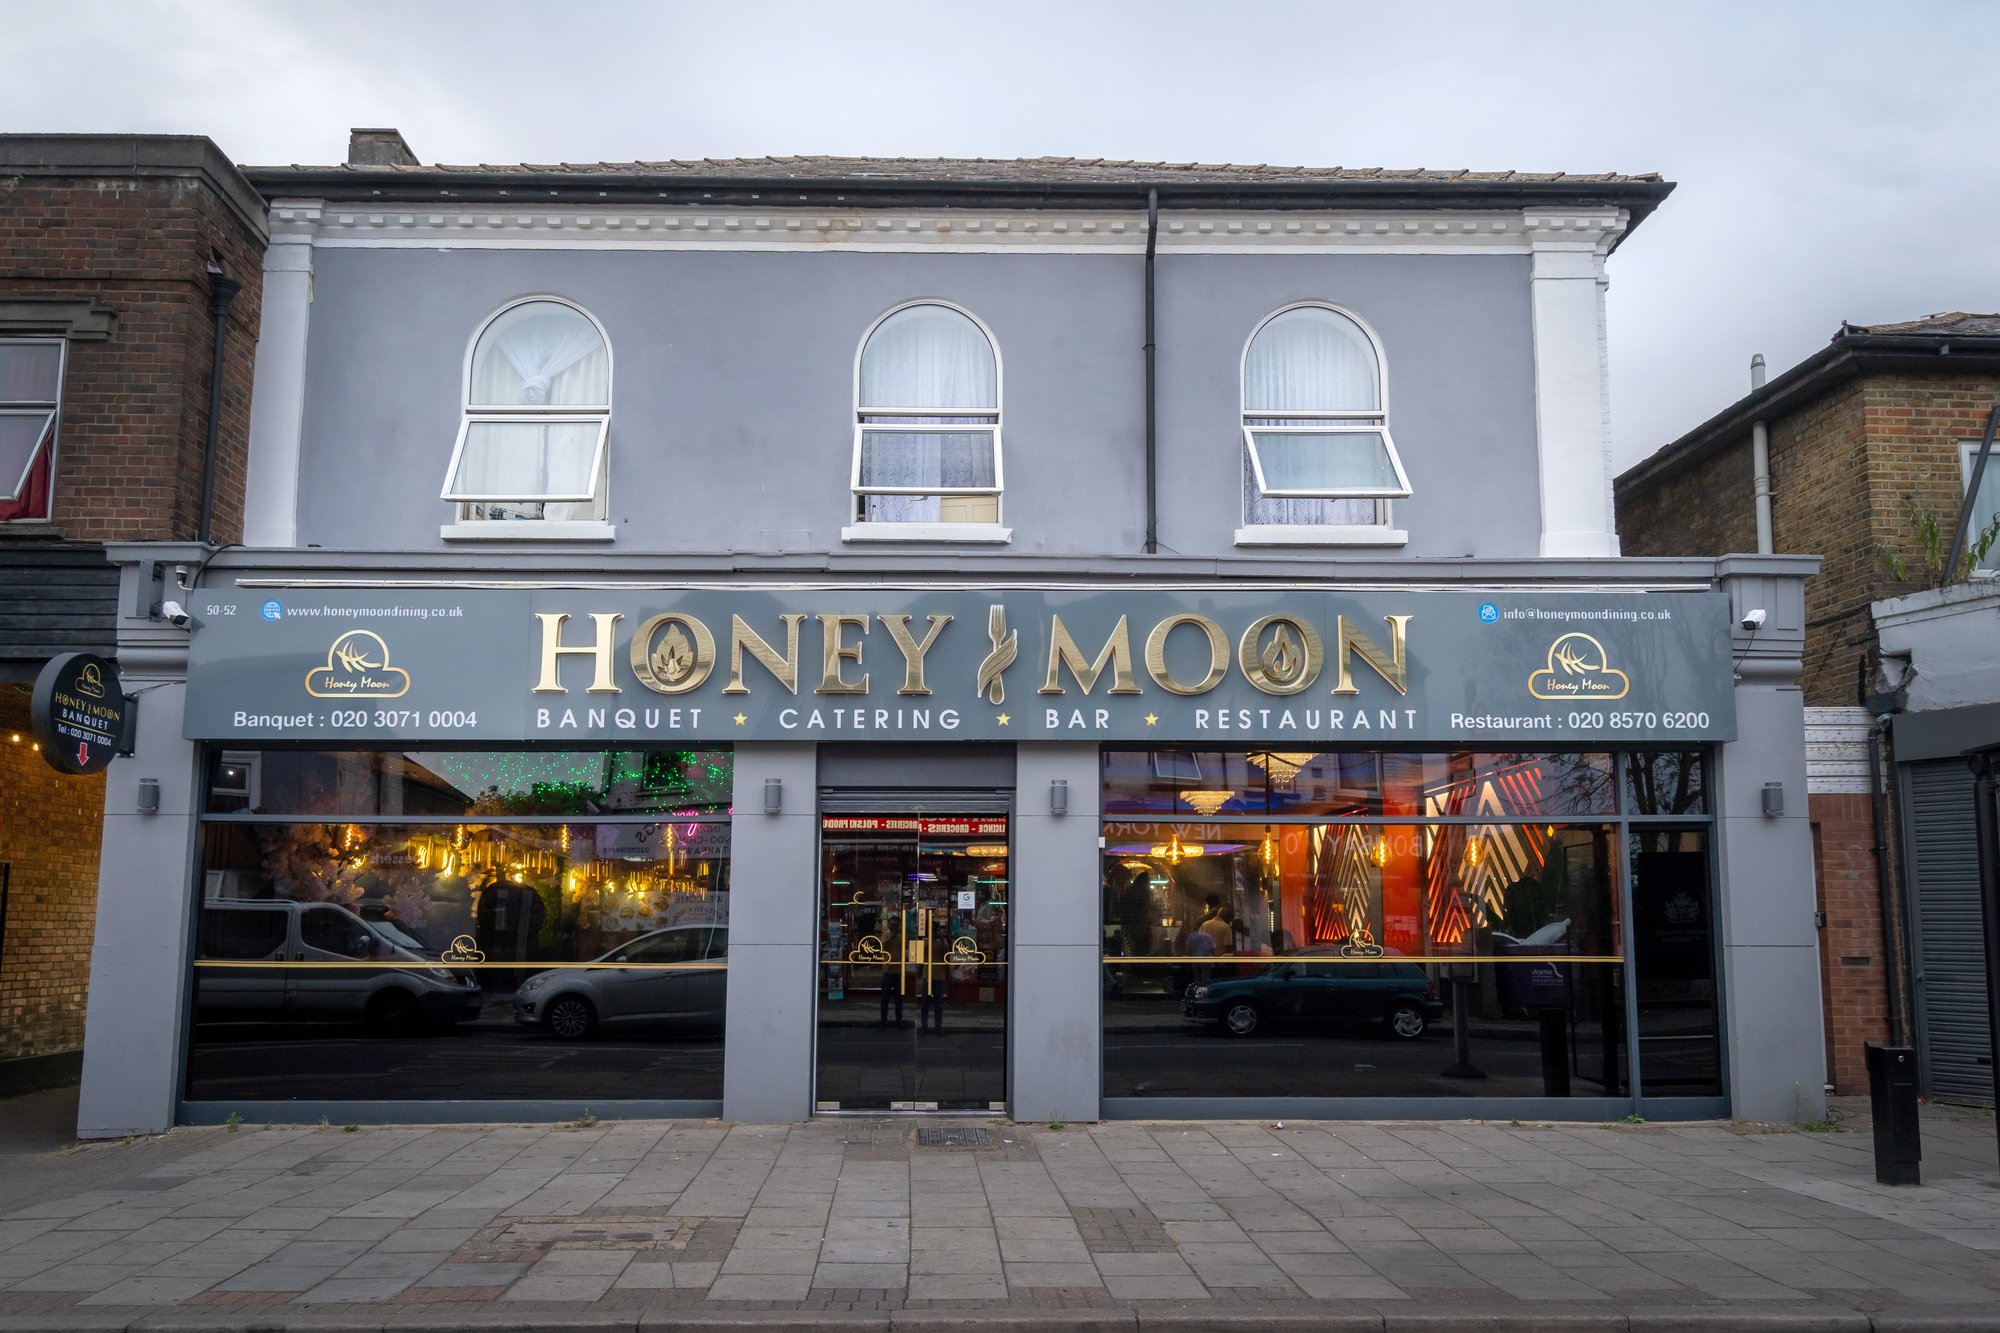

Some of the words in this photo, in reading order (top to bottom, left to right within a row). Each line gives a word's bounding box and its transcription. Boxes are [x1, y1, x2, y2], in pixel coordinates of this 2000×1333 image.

[206, 604, 237, 616] 50-52
[286, 605, 464, 619] www.honeymoondining.co.uk
[1503, 608, 1671, 623] info@honeymoondining.co.uk
[531, 612, 954, 696] HONEY
[1037, 613, 1414, 696] MOON
[324, 676, 358, 692] Honey
[361, 676, 390, 689] Moon
[1547, 677, 1579, 694] Honey
[1582, 678, 1610, 691] Moon
[55, 691, 87, 712] HONEY
[92, 705, 120, 721] MOON
[62, 708, 109, 730] BANQUET
[233, 711, 314, 730] Banquet
[330, 710, 368, 728] 020
[373, 710, 420, 728] 3071
[428, 710, 478, 728] 0004
[536, 708, 702, 729] BANQUET
[779, 708, 960, 730] CATERING
[1046, 708, 1110, 729] BAR
[1195, 708, 1417, 730] RESTAURANT
[1450, 712, 1552, 729] Restaurant
[1568, 711, 1604, 729] 020
[1609, 711, 1657, 729] 8570
[1662, 711, 1710, 729] 6200
[57, 723, 67, 733] Tel
[70, 728, 82, 738] 020
[82, 731, 96, 743] 3071
[97, 735, 112, 746] 0004
